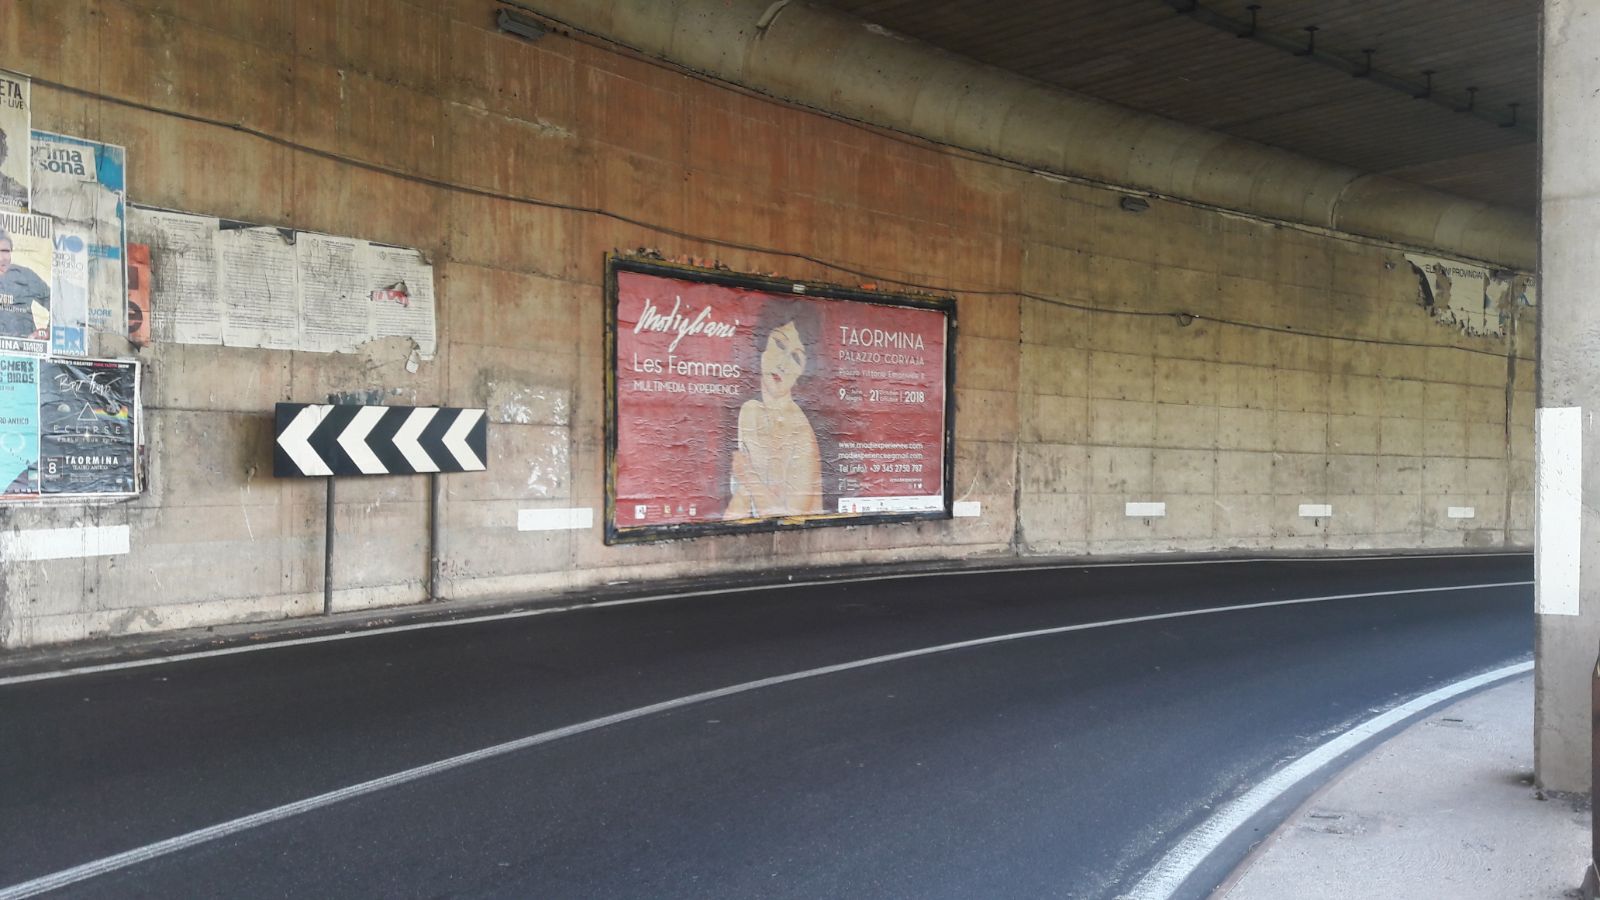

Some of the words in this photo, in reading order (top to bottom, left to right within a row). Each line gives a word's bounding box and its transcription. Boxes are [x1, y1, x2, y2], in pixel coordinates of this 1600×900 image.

[634, 296, 740, 352] Modigliani
[839, 325, 925, 351] TAORMINA
[839, 350, 880, 364] PALAZZO
[884, 354, 925, 366] CORVAJA
[634, 353, 662, 374] Les
[668, 356, 741, 379] Femmes
[7, 372, 35, 384] BIRDS
[634, 380, 686, 393] MULTIMEDIA
[688, 384, 741, 396] EXPERIENCE
[839, 388, 846, 401] 9
[869, 389, 879, 402] 21
[904, 391, 925, 403] 2018
[48, 462, 57, 474] 8
[65, 456, 119, 465] TAORMINA
[839, 464, 849, 473] Tel
[882, 464, 893, 473] 345
